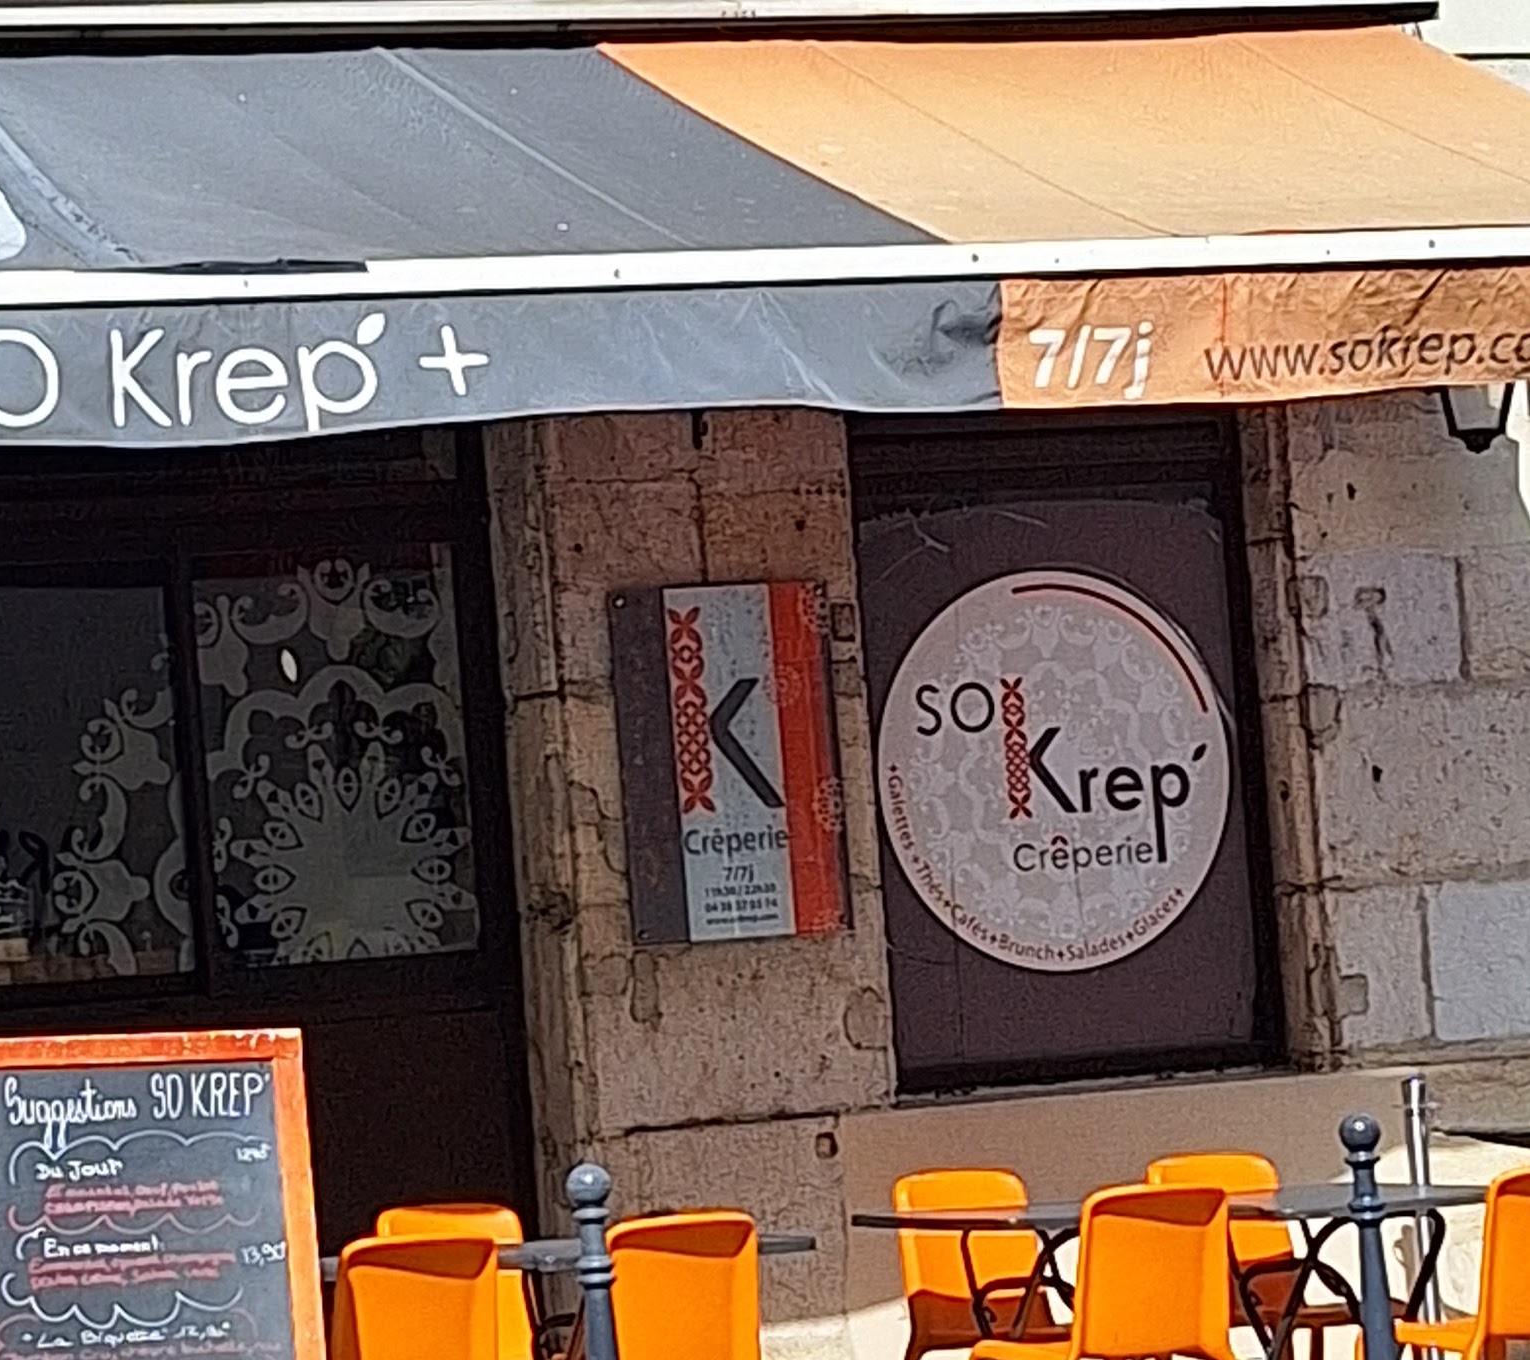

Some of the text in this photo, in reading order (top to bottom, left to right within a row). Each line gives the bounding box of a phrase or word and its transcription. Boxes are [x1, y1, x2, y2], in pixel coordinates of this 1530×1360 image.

[1027, 320, 1154, 401] 7/7j
[915, 681, 995, 737] SO
[683, 824, 789, 858] Crêperie
[887, 775, 915, 850] Galettes
[998, 934, 1054, 961] Brunch
[1066, 933, 1128, 962] Salades
[1133, 896, 1178, 937] Glaces
[1012, 834, 1154, 875] Crêperie
[721, 864, 754, 883] 7/7j
[4, 1075, 138, 1150] Suggestions
[150, 1072, 184, 1119] SO
